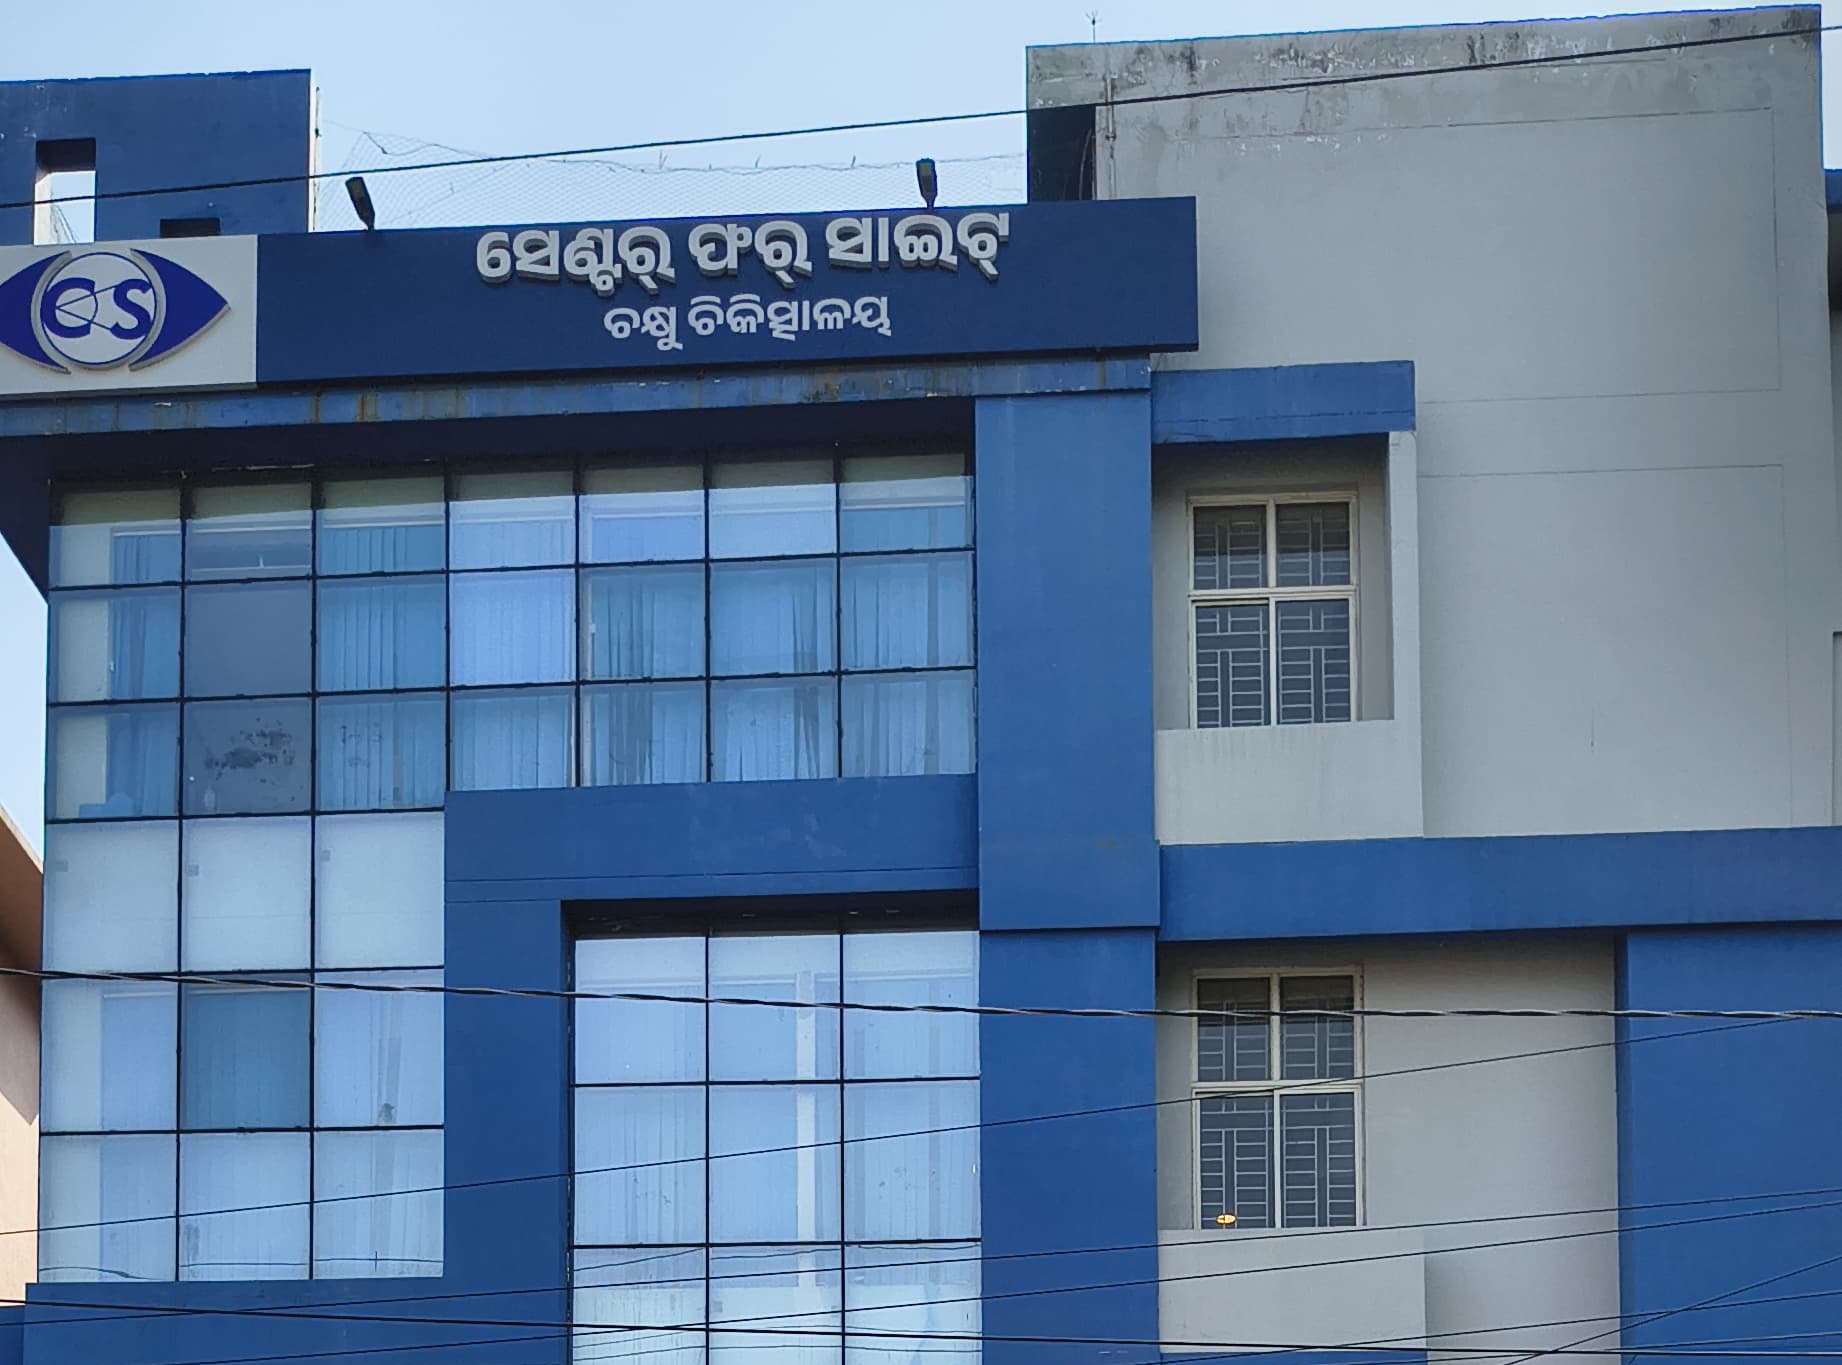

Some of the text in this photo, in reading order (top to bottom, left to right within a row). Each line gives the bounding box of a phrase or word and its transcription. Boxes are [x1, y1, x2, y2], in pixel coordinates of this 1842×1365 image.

[476, 212, 1009, 296] ସେଣ୍ଟର୍ ଫର୍ ସାଇଟ୍
[604, 304, 683, 351] ଚକ୍ଷୁ
